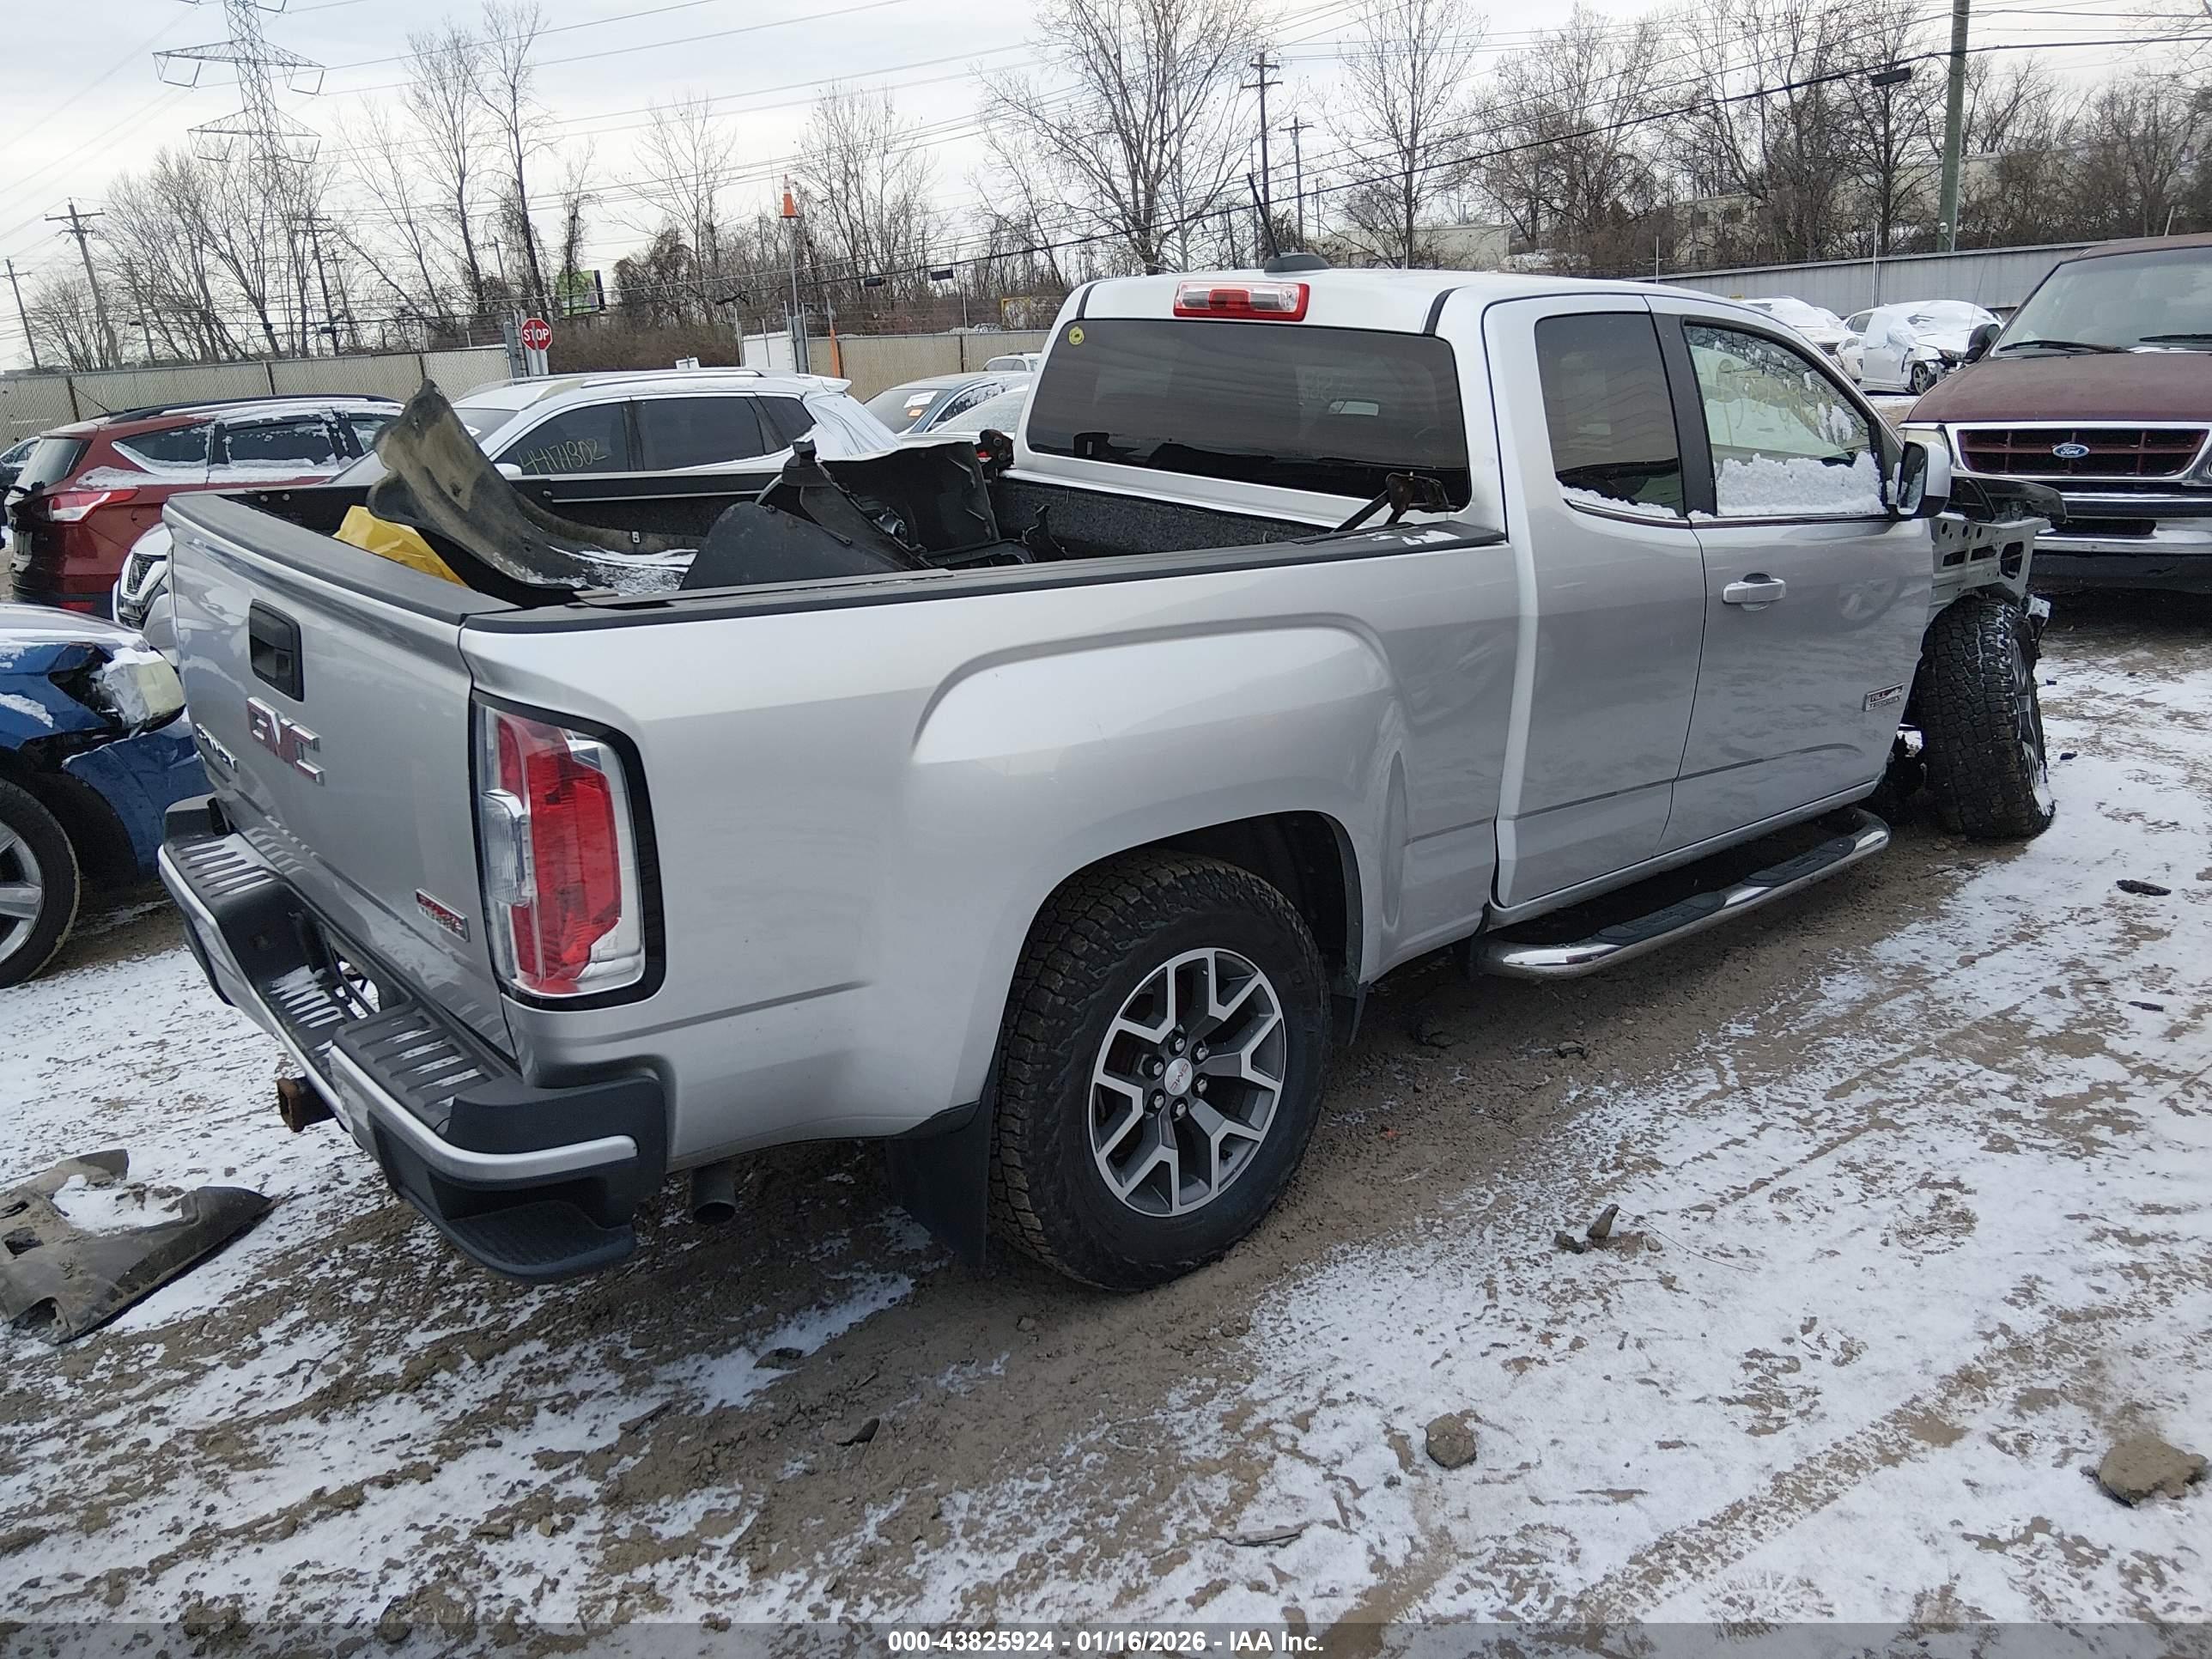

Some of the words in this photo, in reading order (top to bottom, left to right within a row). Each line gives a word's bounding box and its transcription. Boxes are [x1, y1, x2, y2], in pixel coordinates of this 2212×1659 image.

[523, 328, 550, 342] STOP
[246, 696, 325, 786] GMC
[1170, 1063, 1188, 1091] GMC
